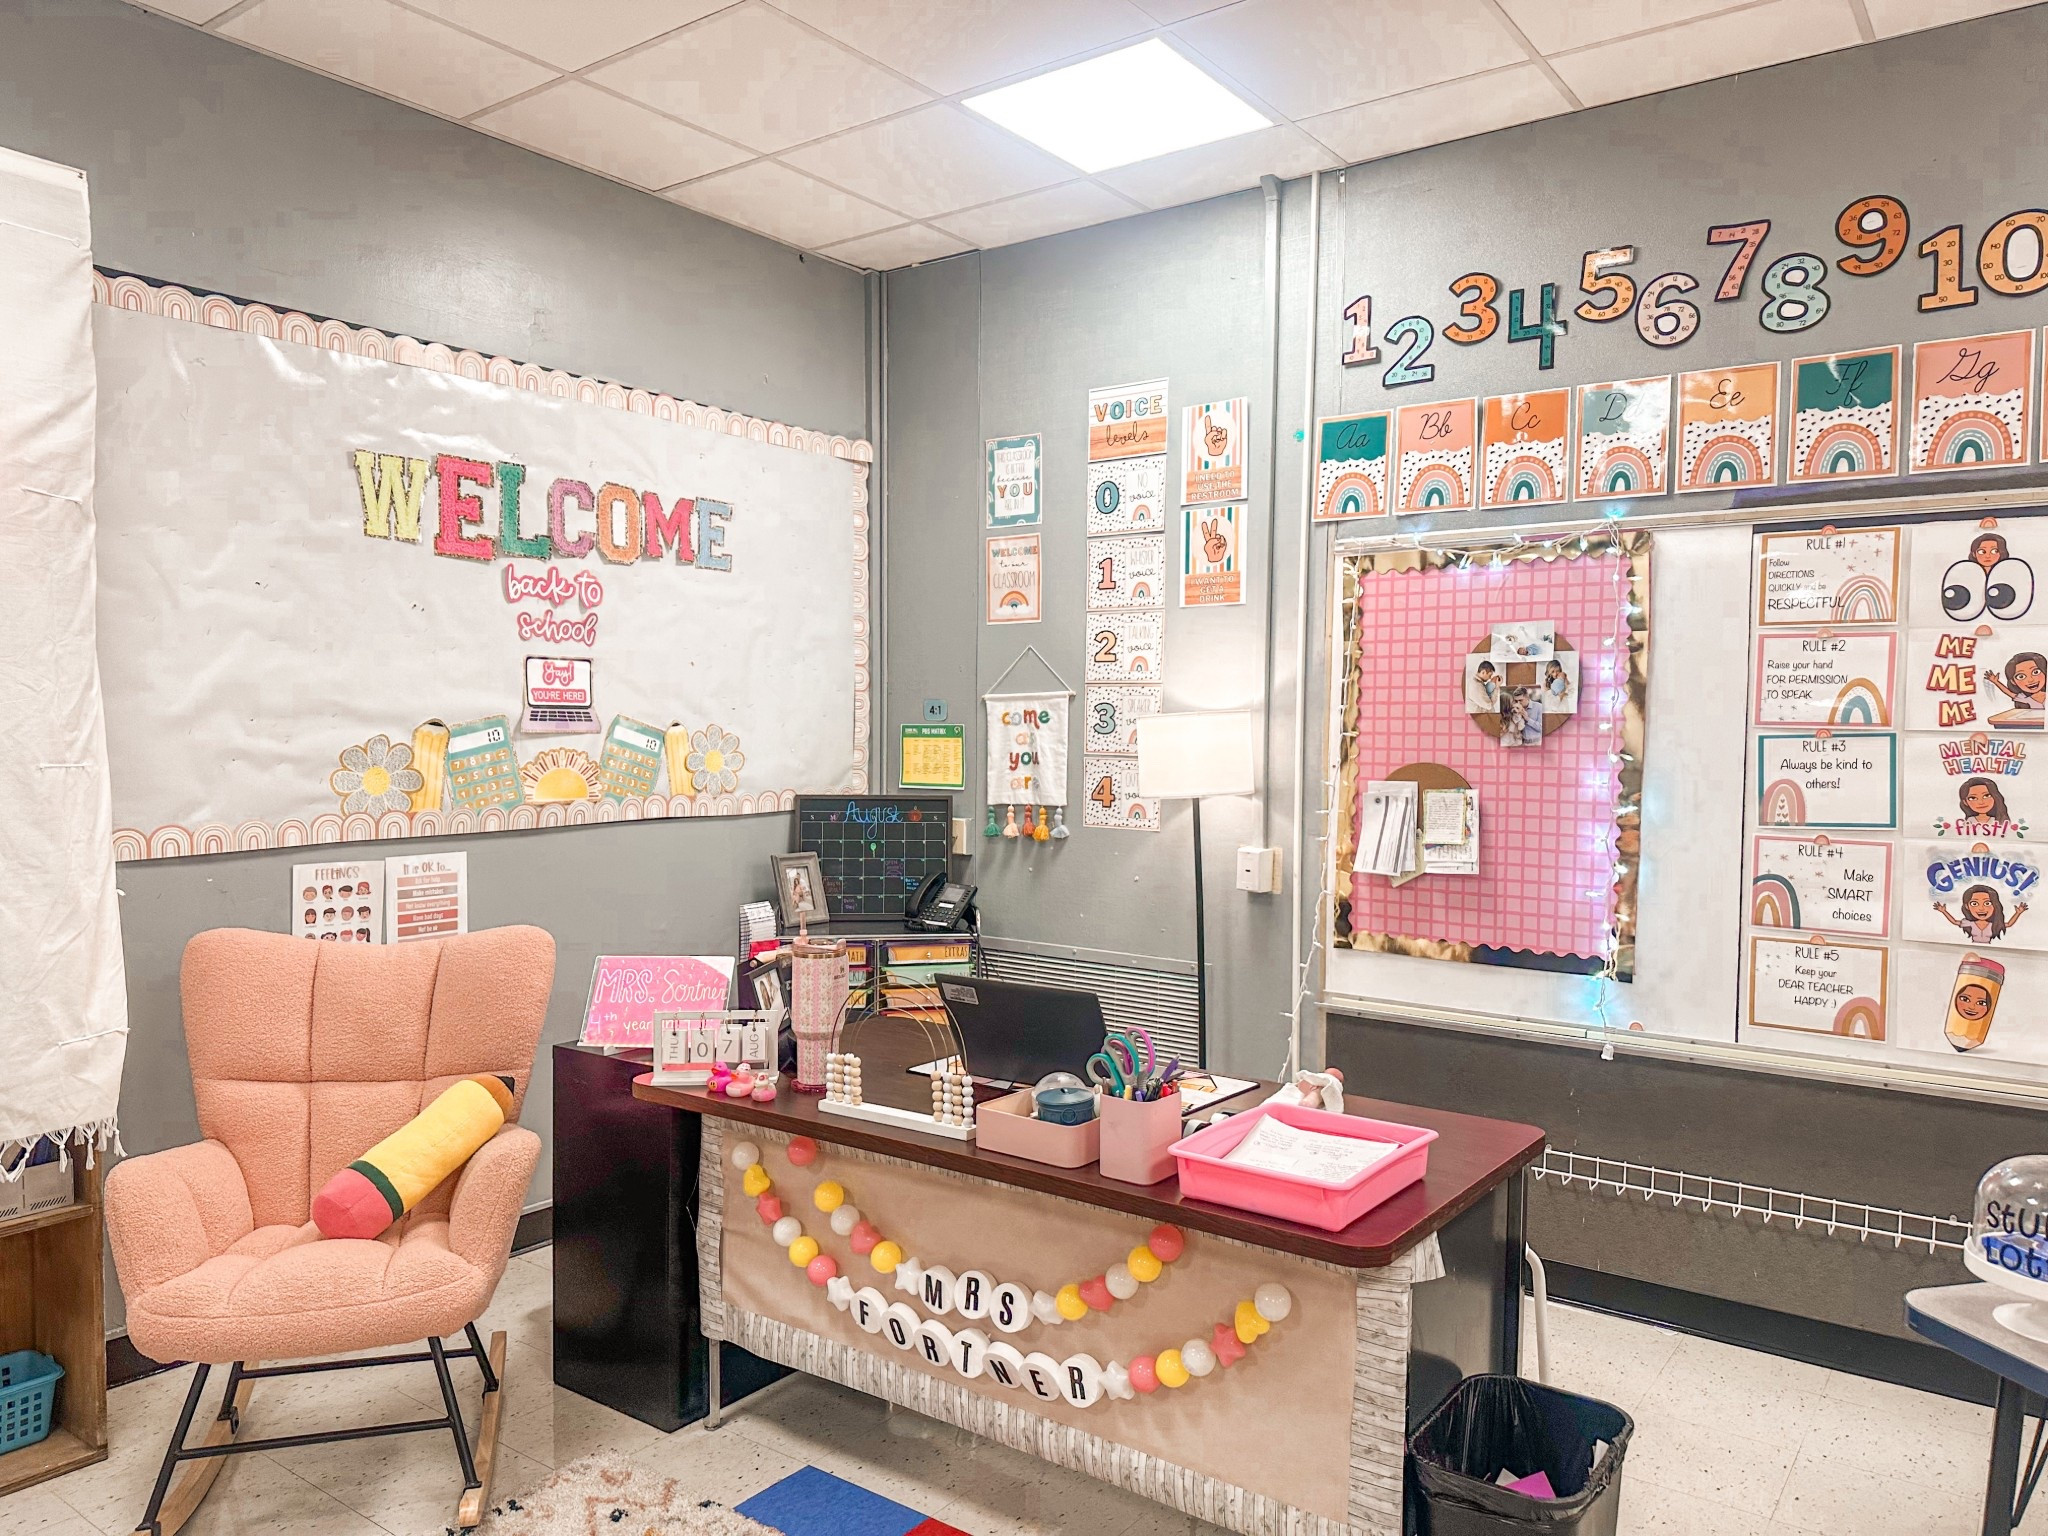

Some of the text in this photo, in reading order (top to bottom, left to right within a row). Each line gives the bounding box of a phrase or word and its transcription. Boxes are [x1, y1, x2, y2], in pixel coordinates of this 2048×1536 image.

[1342, 195, 2048, 387] 1 2 3 4 5 6 7 8 9 10
[1936, 348, 2000, 393] Gg
[1709, 379, 1745, 411] Ee
[1094, 395, 1163, 422] VOICE
[1511, 402, 1541, 430] Cc
[1418, 411, 1453, 440] Bb
[1105, 421, 1150, 446] levels
[1336, 424, 1370, 450] Aa
[1200, 472, 1222, 480] NEED
[997, 482, 1032, 498] YOU
[1197, 480, 1232, 491] USE THE
[1095, 481, 1120, 514] 0
[1129, 490, 1156, 502] voice
[1191, 489, 1239, 500] RESTROOM
[354, 449, 734, 572] WELCOME
[1807, 537, 1846, 550] RULE #1
[992, 546, 1038, 557] WELCOME
[1769, 559, 1789, 567] Follow
[993, 571, 1035, 588] CLASSROOM
[1097, 557, 1116, 590] 1
[1129, 568, 1156, 579] voice
[1195, 576, 1220, 585] WANT
[1769, 570, 1815, 579] DIRECTIONS
[506, 564, 604, 608] back to
[1200, 585, 1216, 593] GET
[1769, 583, 1801, 592] QUICKLY
[1200, 594, 1225, 602] DRINK
[1768, 596, 1845, 610] RESPECTFUL
[518, 610, 598, 647] school
[1094, 630, 1117, 662] 2
[1127, 643, 1154, 653] voice
[1802, 639, 1846, 652] RULE #2
[1935, 634, 1977, 659] ME
[1768, 659, 1833, 671] Raise your hand
[1767, 674, 1848, 684] FOR PERMISSION
[1927, 664, 1976, 695] ME
[1767, 689, 1813, 699] TO SPEAK
[929, 706, 942, 715] 4:1
[1939, 700, 1977, 727] ME
[1002, 710, 1050, 730] come
[1093, 702, 1116, 735] 3
[1802, 739, 1846, 753] RULE #3
[1939, 739, 2027, 759] MENTAL
[1009, 752, 1039, 771] you
[1780, 759, 1873, 773] Always be kind to
[1943, 757, 2023, 776] HEALTH
[1805, 778, 1840, 789] others!
[1091, 776, 1115, 808] 4
[844, 801, 904, 839] August
[1798, 845, 1844, 859] RULE #4
[315, 866, 360, 880] FEELINGS
[422, 862, 434, 872] OK
[1843, 869, 1874, 882] Make
[1927, 856, 2036, 897] GENIUS!
[1828, 888, 1873, 902] SMART
[1832, 910, 1872, 922] choices
[945, 946, 968, 958] EXTRAS
[1795, 946, 1840, 961] RULE #5
[1795, 965, 1837, 978] Keep your
[594, 969, 655, 1004] MRS.
[1778, 979, 1853, 995] DEAR TEACHER
[1794, 996, 1830, 1008] HAPPY
[623, 1019, 652, 1035] year
[670, 1038, 679, 1060] THU
[750, 1034, 759, 1058] AUG
[925, 1273, 1014, 1325] MRS
[859, 1300, 1087, 1400] FORTNER
